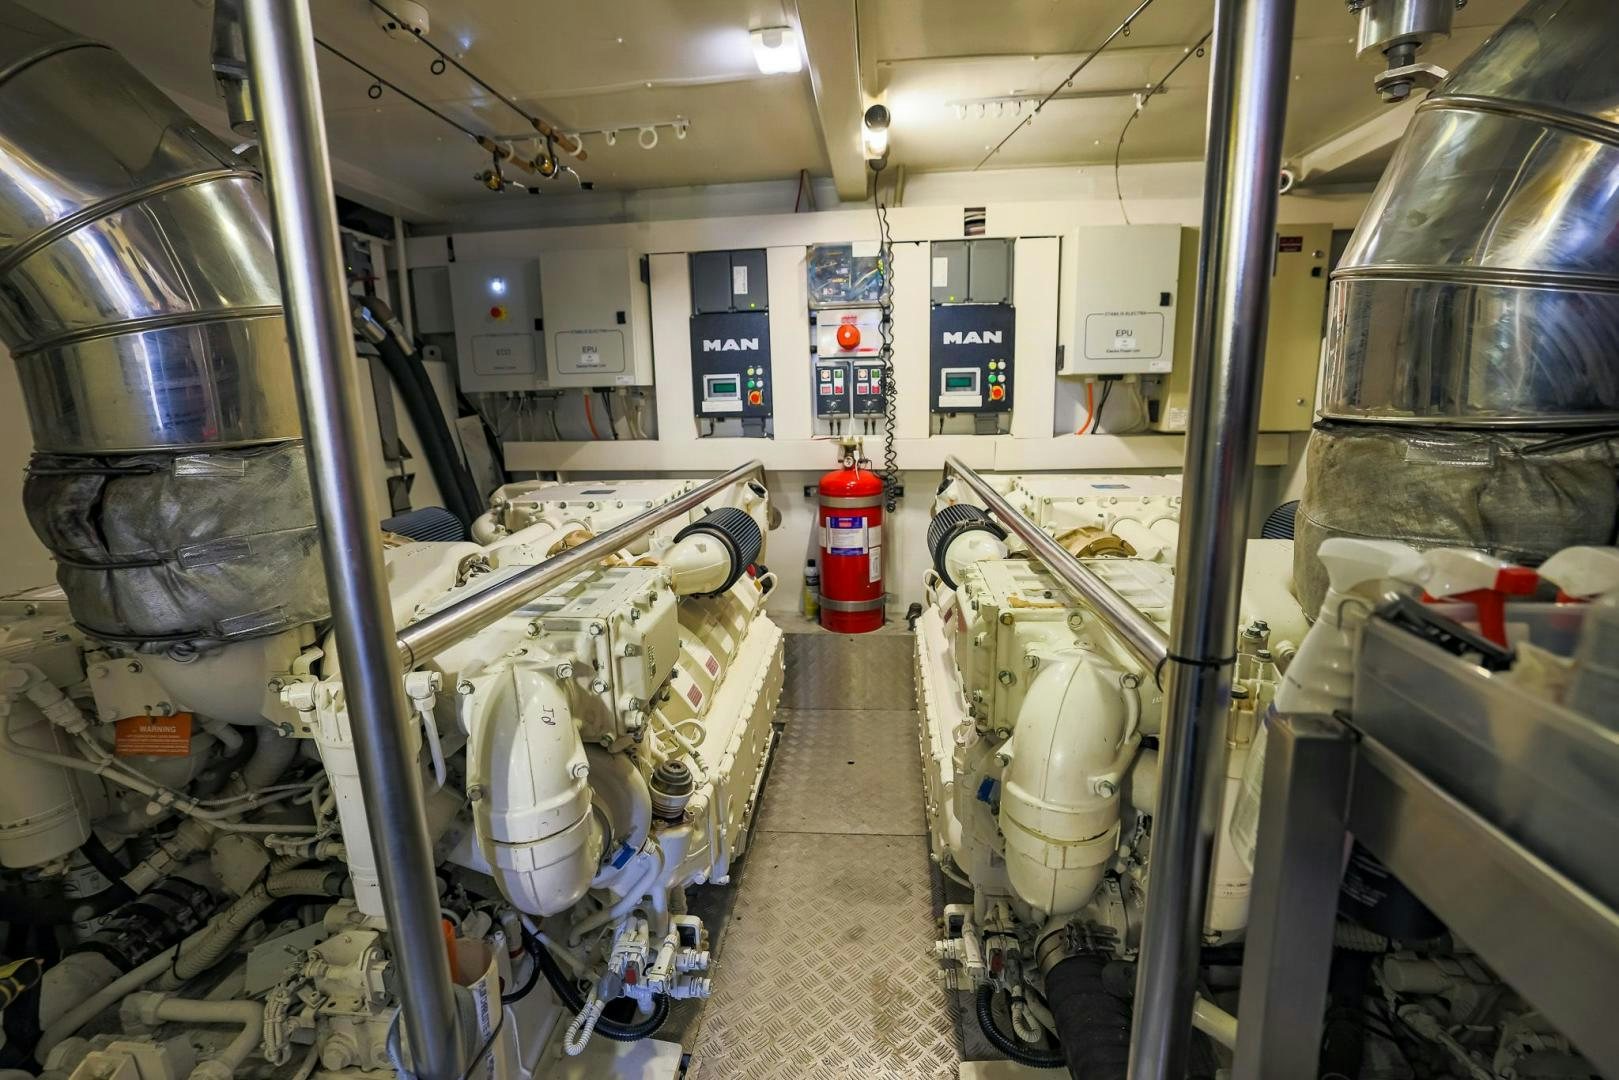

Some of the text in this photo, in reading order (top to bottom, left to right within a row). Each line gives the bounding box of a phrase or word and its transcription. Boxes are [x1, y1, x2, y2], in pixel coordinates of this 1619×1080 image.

[1115, 329, 1133, 337] EPU
[943, 330, 1003, 345] MAN
[582, 345, 598, 353] EPU
[703, 338, 759, 352] MAN
[139, 725, 177, 733] WARNING
